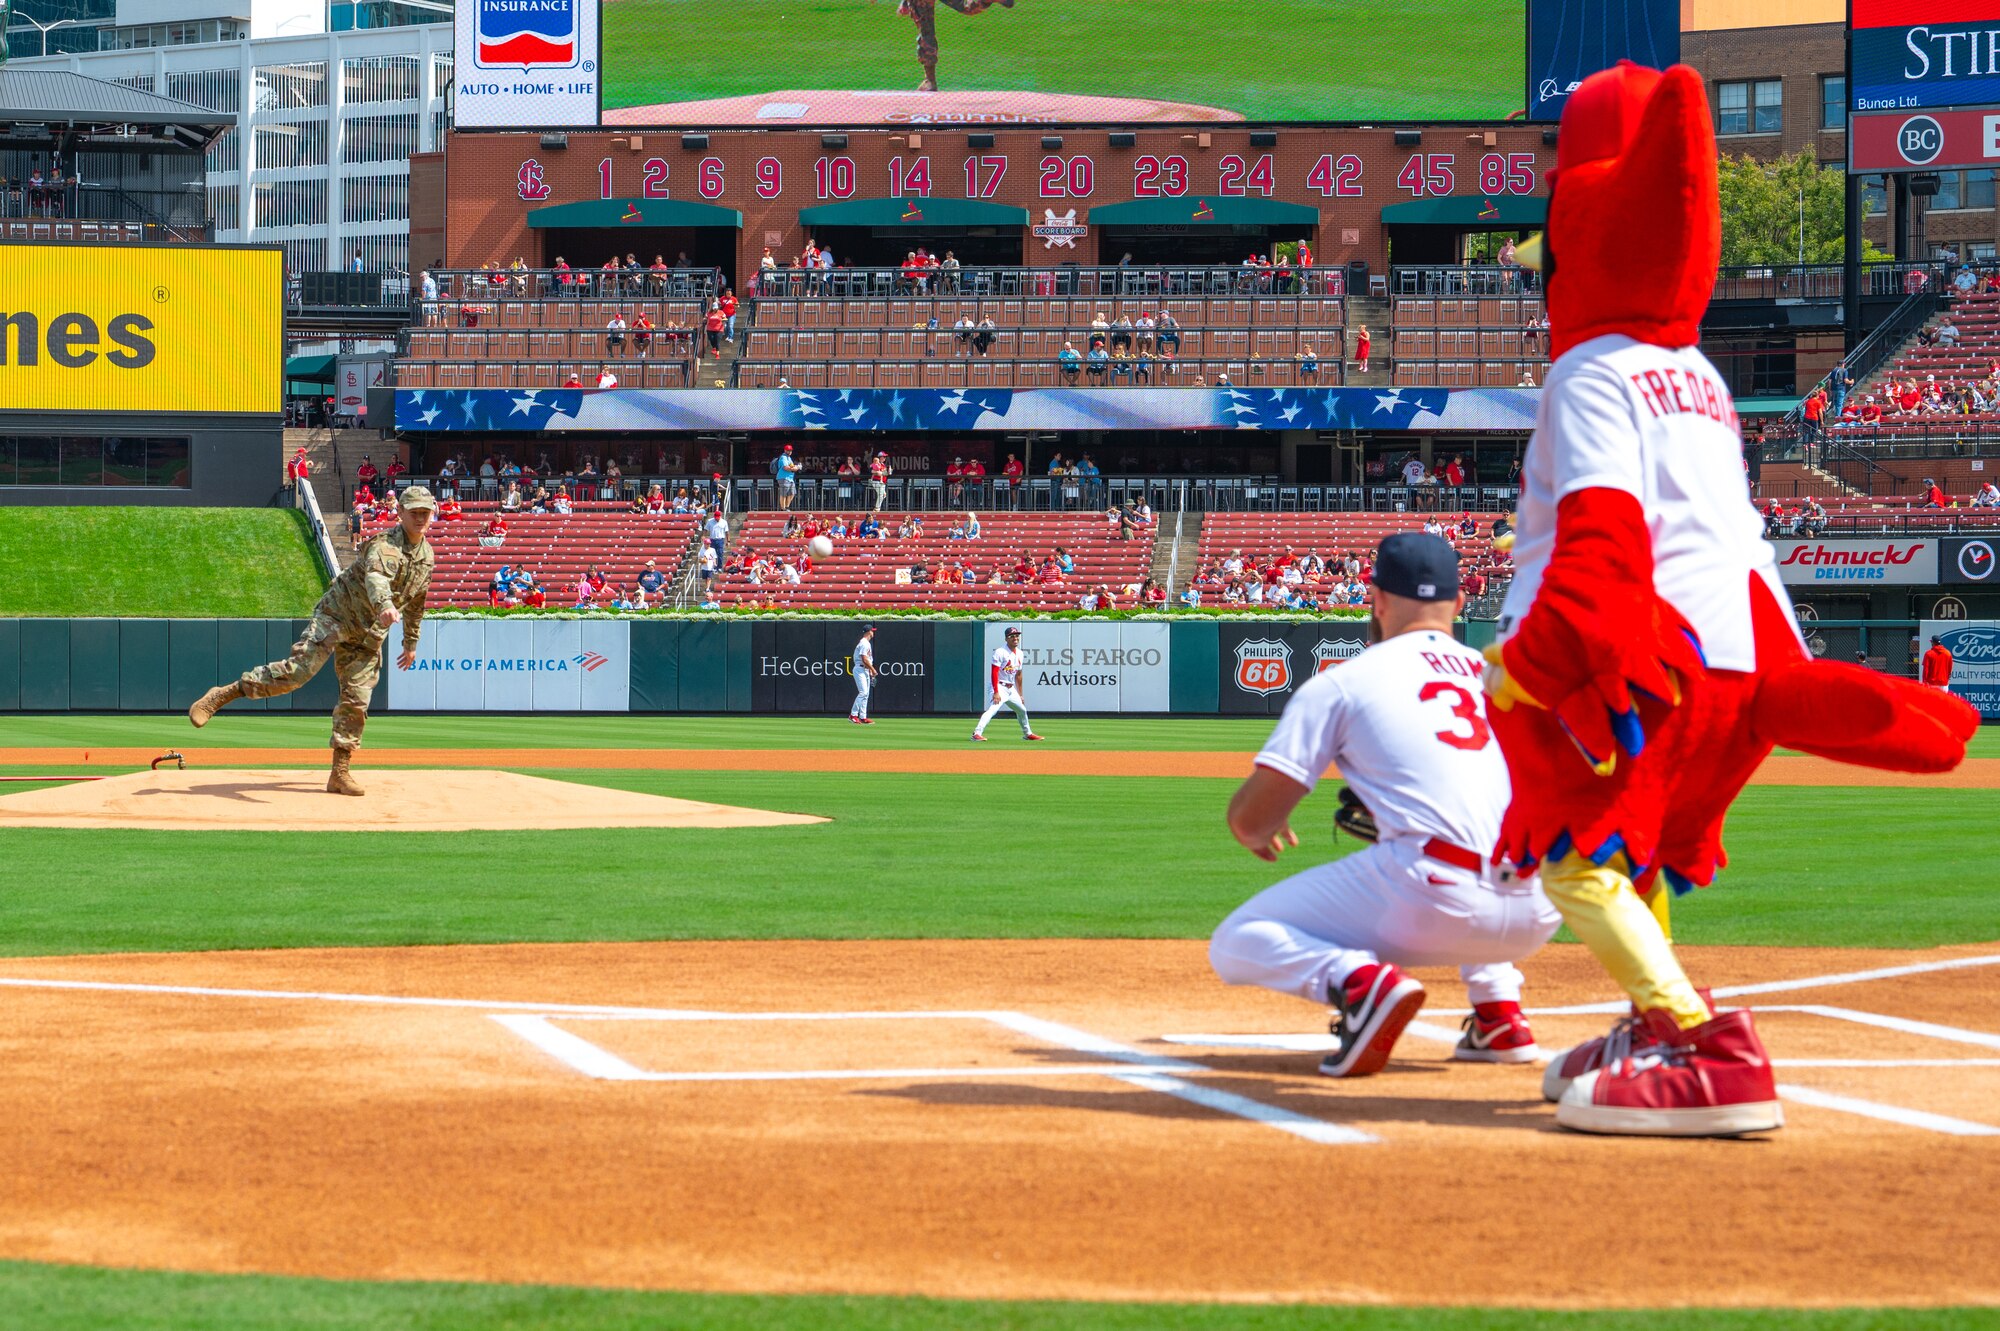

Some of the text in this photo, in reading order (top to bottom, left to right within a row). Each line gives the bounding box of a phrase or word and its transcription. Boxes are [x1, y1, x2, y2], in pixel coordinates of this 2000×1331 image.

[484, 0, 569, 11] INSURANCE
[460, 83, 593, 95] AUTO HOME LIFE
[1899, 96, 1921, 107] Ltd.
[1905, 128, 1936, 151] BC
[599, 153, 1535, 199] 1 2 6 9 10 14 17 20 23 24 42 45 85
[1035, 227, 1086, 235] SCOREBOARD
[1815, 568, 1885, 579] DELIVERS
[1940, 604, 1959, 618] JH
[1081, 648, 1161, 666] FARGO
[1244, 647, 1283, 657] PHILLIPS
[1321, 647, 1361, 658] PHILLIPS
[460, 659, 482, 671] OF
[487, 659, 568, 671] AMERICA
[1037, 671, 1117, 686] Advisors
[1246, 662, 1281, 683] 66
[1965, 692, 1996, 702] TRUCK
